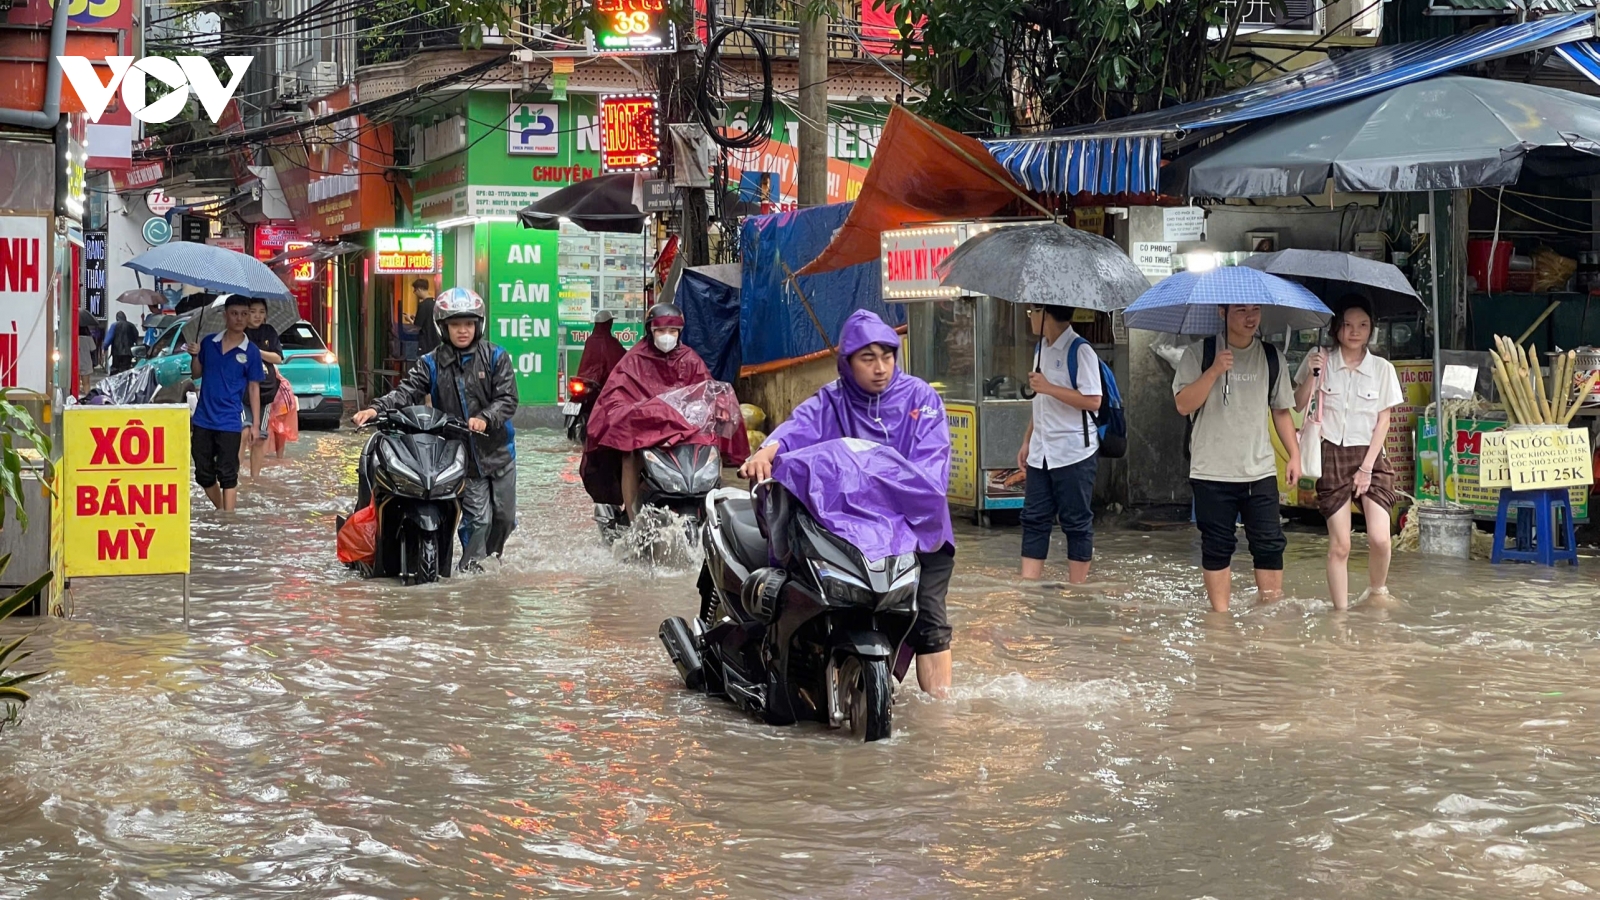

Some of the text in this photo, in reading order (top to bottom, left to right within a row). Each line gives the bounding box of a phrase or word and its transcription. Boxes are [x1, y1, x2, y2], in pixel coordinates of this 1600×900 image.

[614, 11, 650, 34] 38
[533, 164, 593, 183] CHUYÊN
[86, 236, 105, 260] RĂNG
[507, 244, 541, 264] AN
[380, 253, 432, 267] THIÊN PHÚC
[888, 241, 912, 282] BÁNH
[1140, 255, 1153, 263] CHO
[498, 280, 550, 303] TÂM
[89, 292, 100, 315] MỸ
[497, 314, 550, 341] TIỆN
[614, 326, 638, 342] TỐT
[1400, 368, 1416, 383] TẮC
[89, 419, 165, 465] XÔI
[1510, 431, 1585, 450] NƯỚC MÍA
[1571, 455, 1584, 463] 15K
[1520, 466, 1584, 484] LÍT 25K
[76, 478, 178, 517] BÁNH
[97, 522, 156, 561] MỲ
